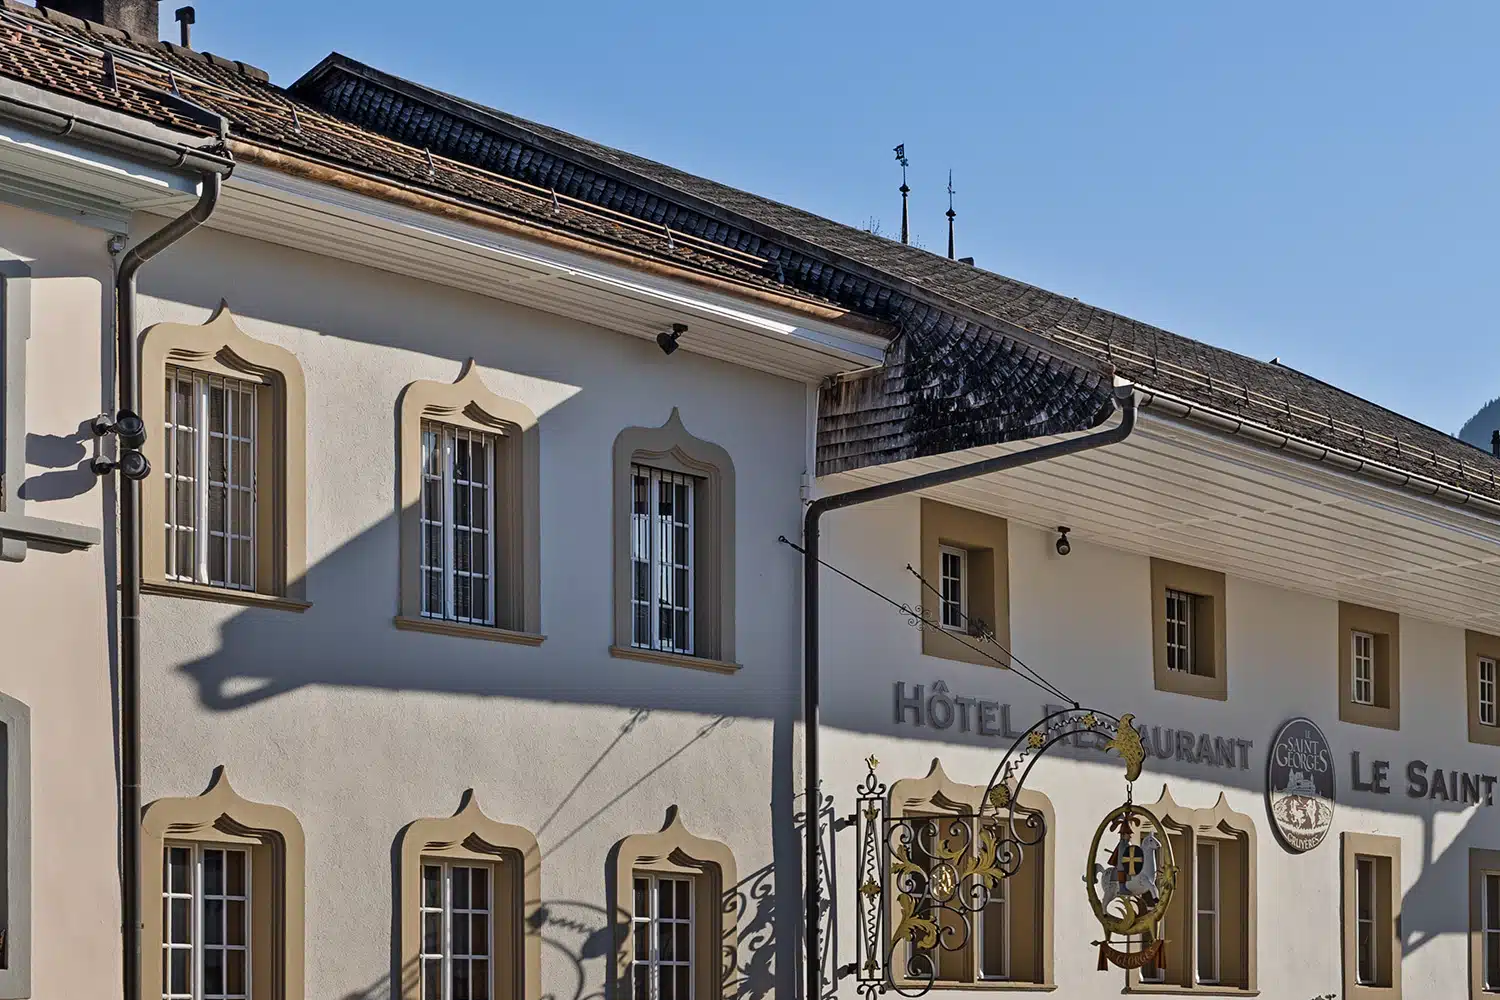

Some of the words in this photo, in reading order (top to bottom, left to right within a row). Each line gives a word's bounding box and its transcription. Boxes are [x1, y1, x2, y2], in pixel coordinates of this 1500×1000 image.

[892, 680, 1019, 742] HÔTEL
[1275, 743, 1328, 773] GEORGES
[1287, 737, 1319, 755] SAINT
[1350, 751, 1391, 795] LE
[1404, 759, 1498, 806] SAINT
